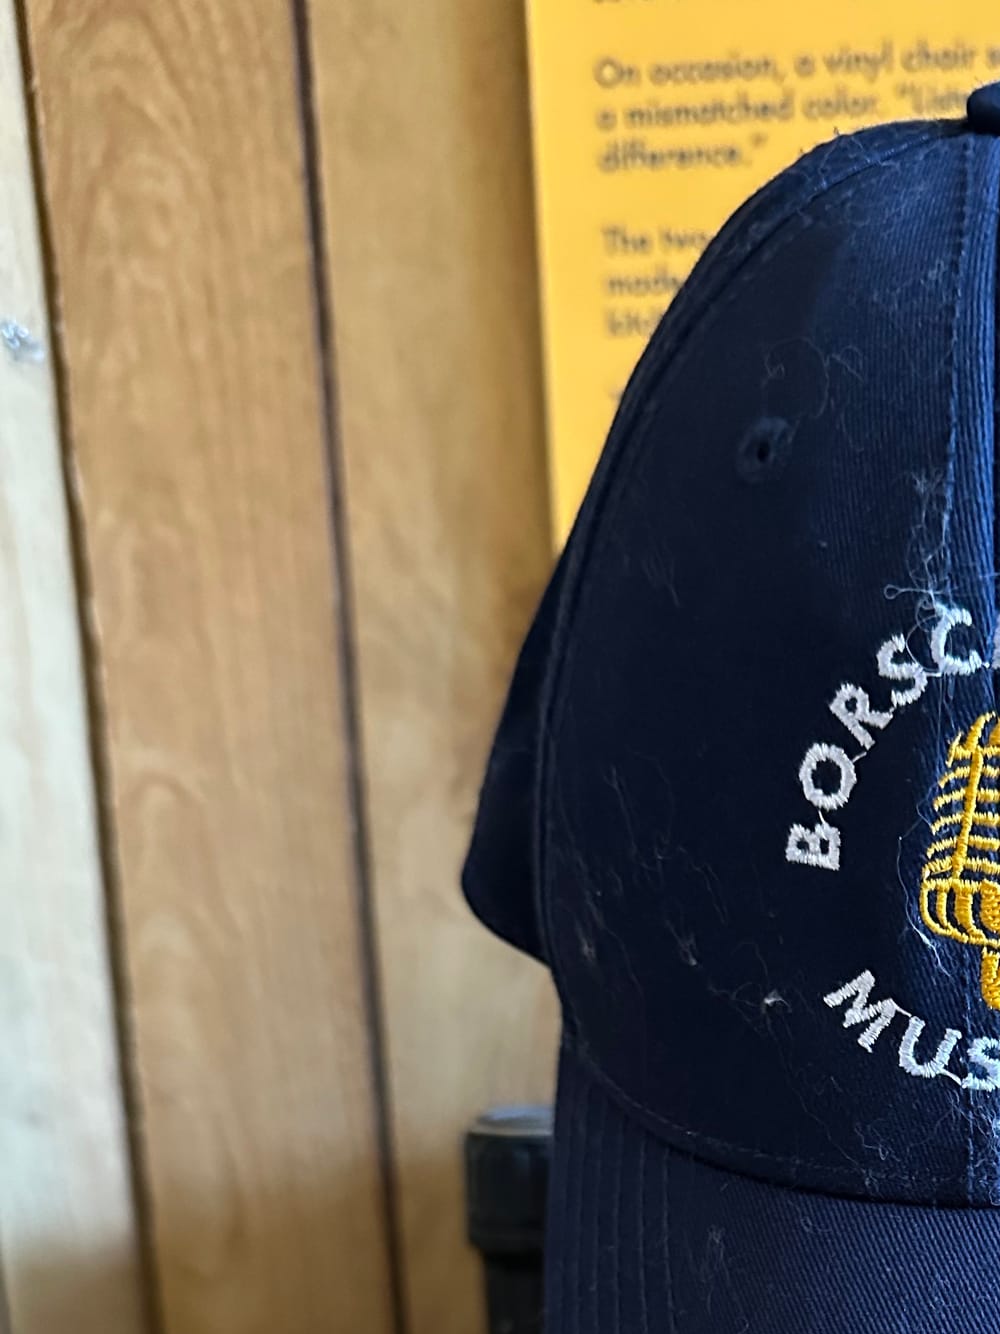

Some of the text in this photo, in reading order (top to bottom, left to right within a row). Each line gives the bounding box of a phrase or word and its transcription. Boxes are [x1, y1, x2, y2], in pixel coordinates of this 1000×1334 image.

[594, 56, 641, 88] On
[824, 40, 893, 82] vinyl
[902, 38, 976, 72] chair
[625, 88, 794, 126] mismatched
[601, 222, 651, 255] The
